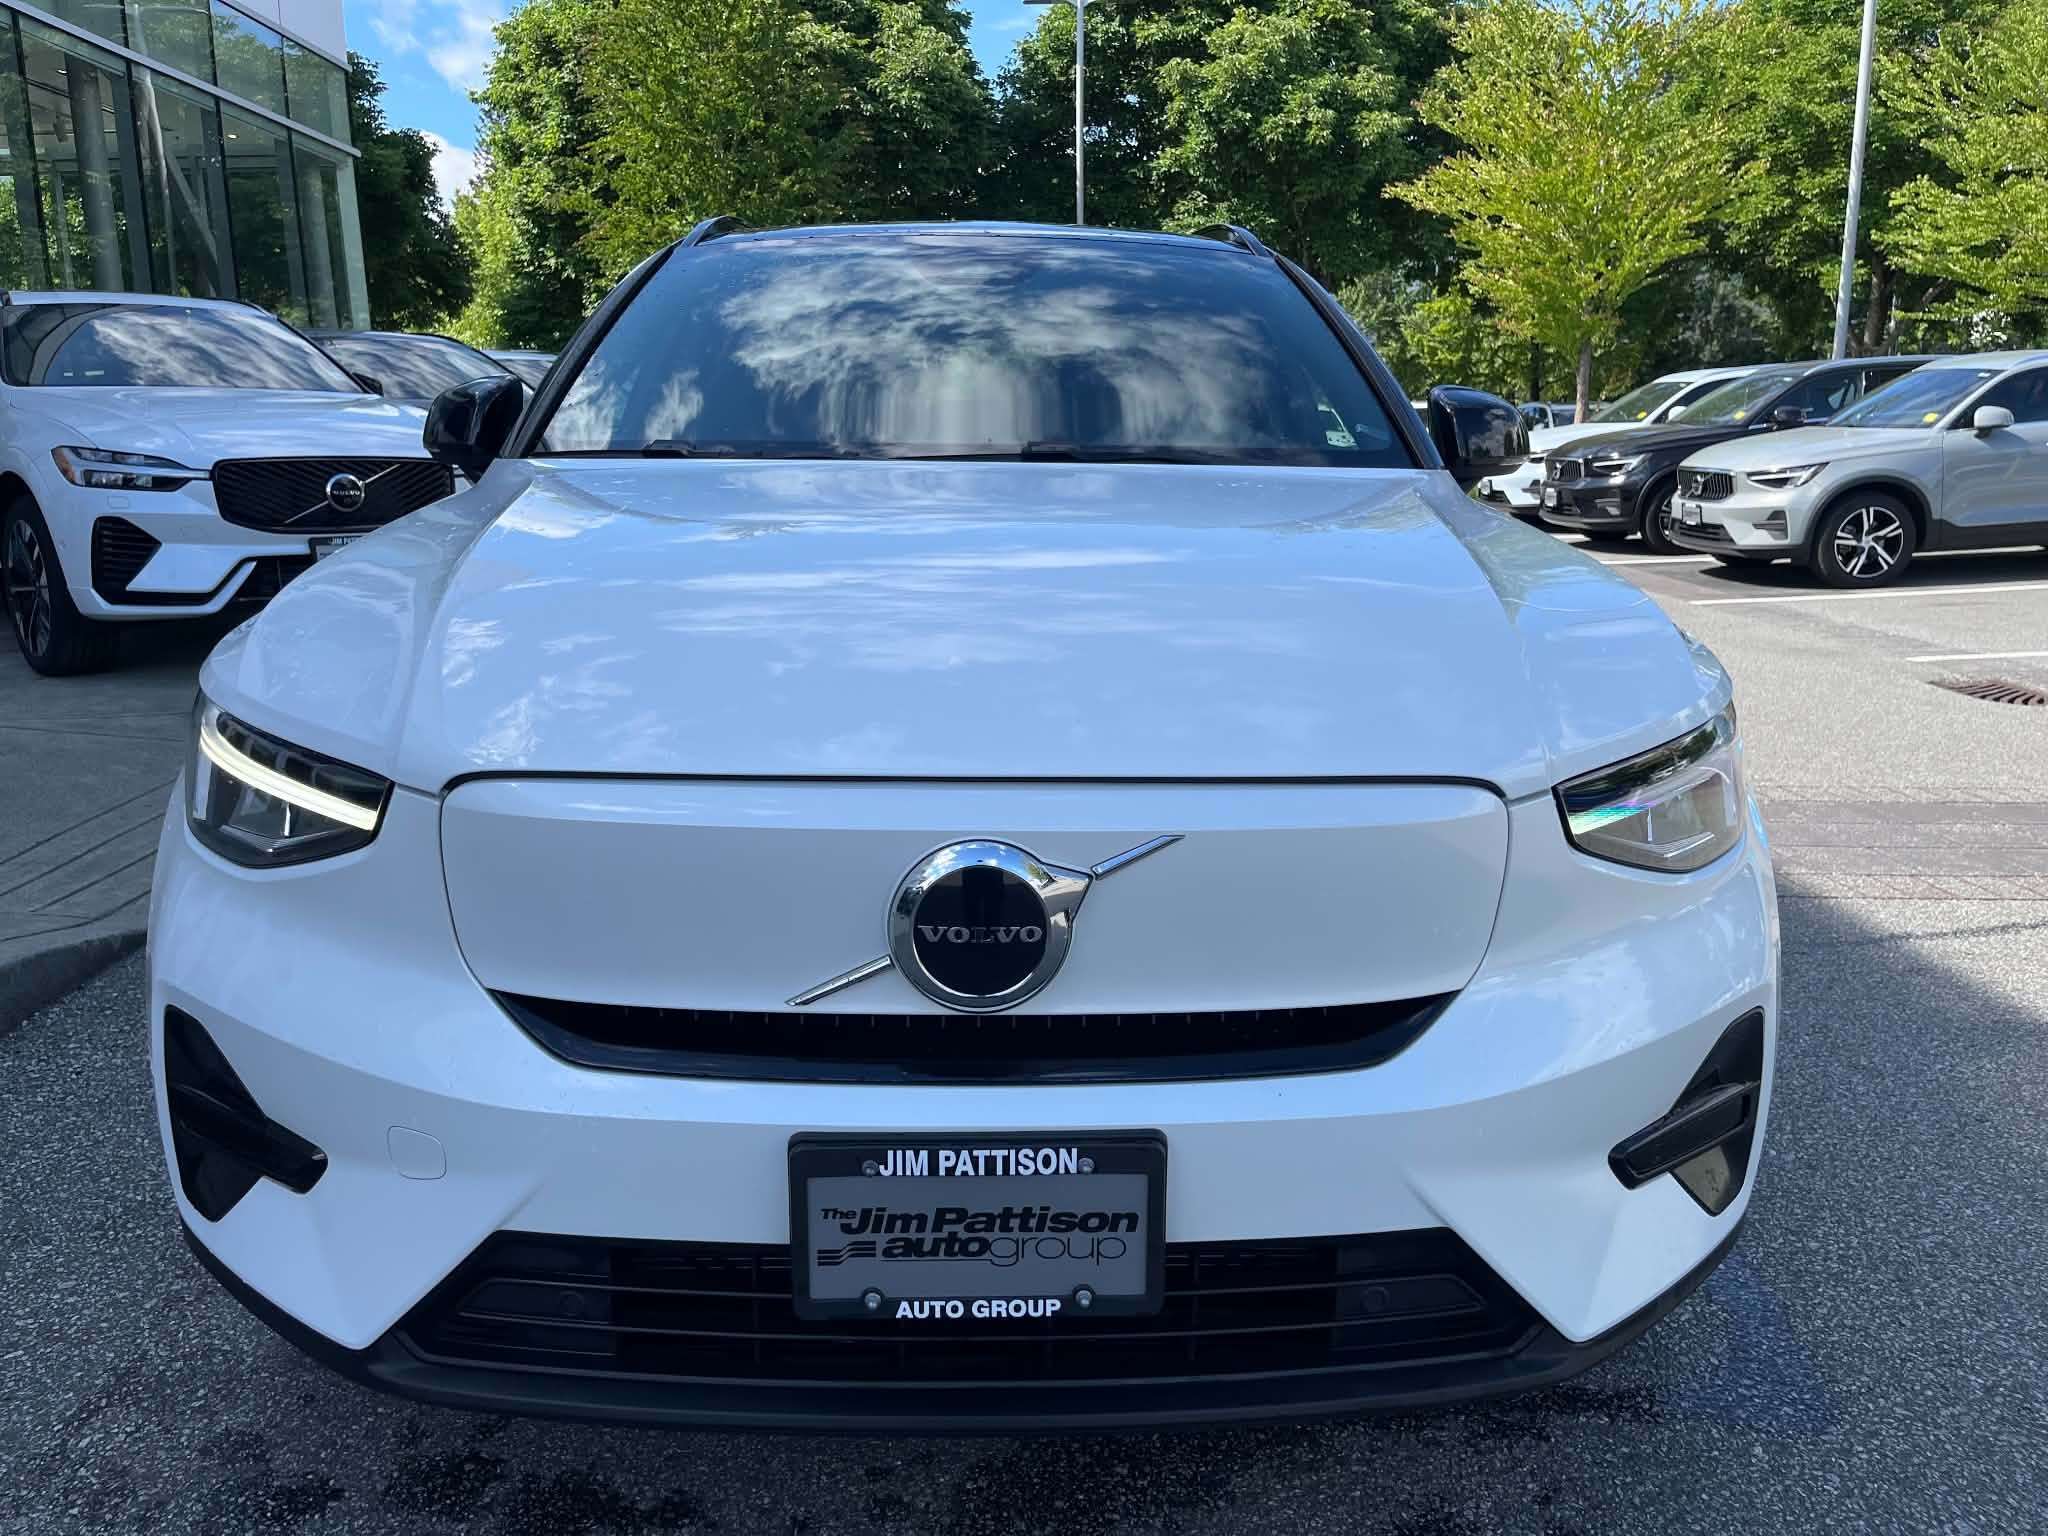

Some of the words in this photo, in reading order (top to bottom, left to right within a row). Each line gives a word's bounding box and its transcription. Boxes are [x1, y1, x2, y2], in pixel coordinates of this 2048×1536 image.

[917, 925, 1043, 944] VOLVO
[879, 1149, 929, 1177] JIM
[938, 1147, 1078, 1176] PATTISON
[821, 1208, 857, 1221] The
[895, 1300, 965, 1320] AUTO
[971, 1298, 1061, 1318] GROUP
